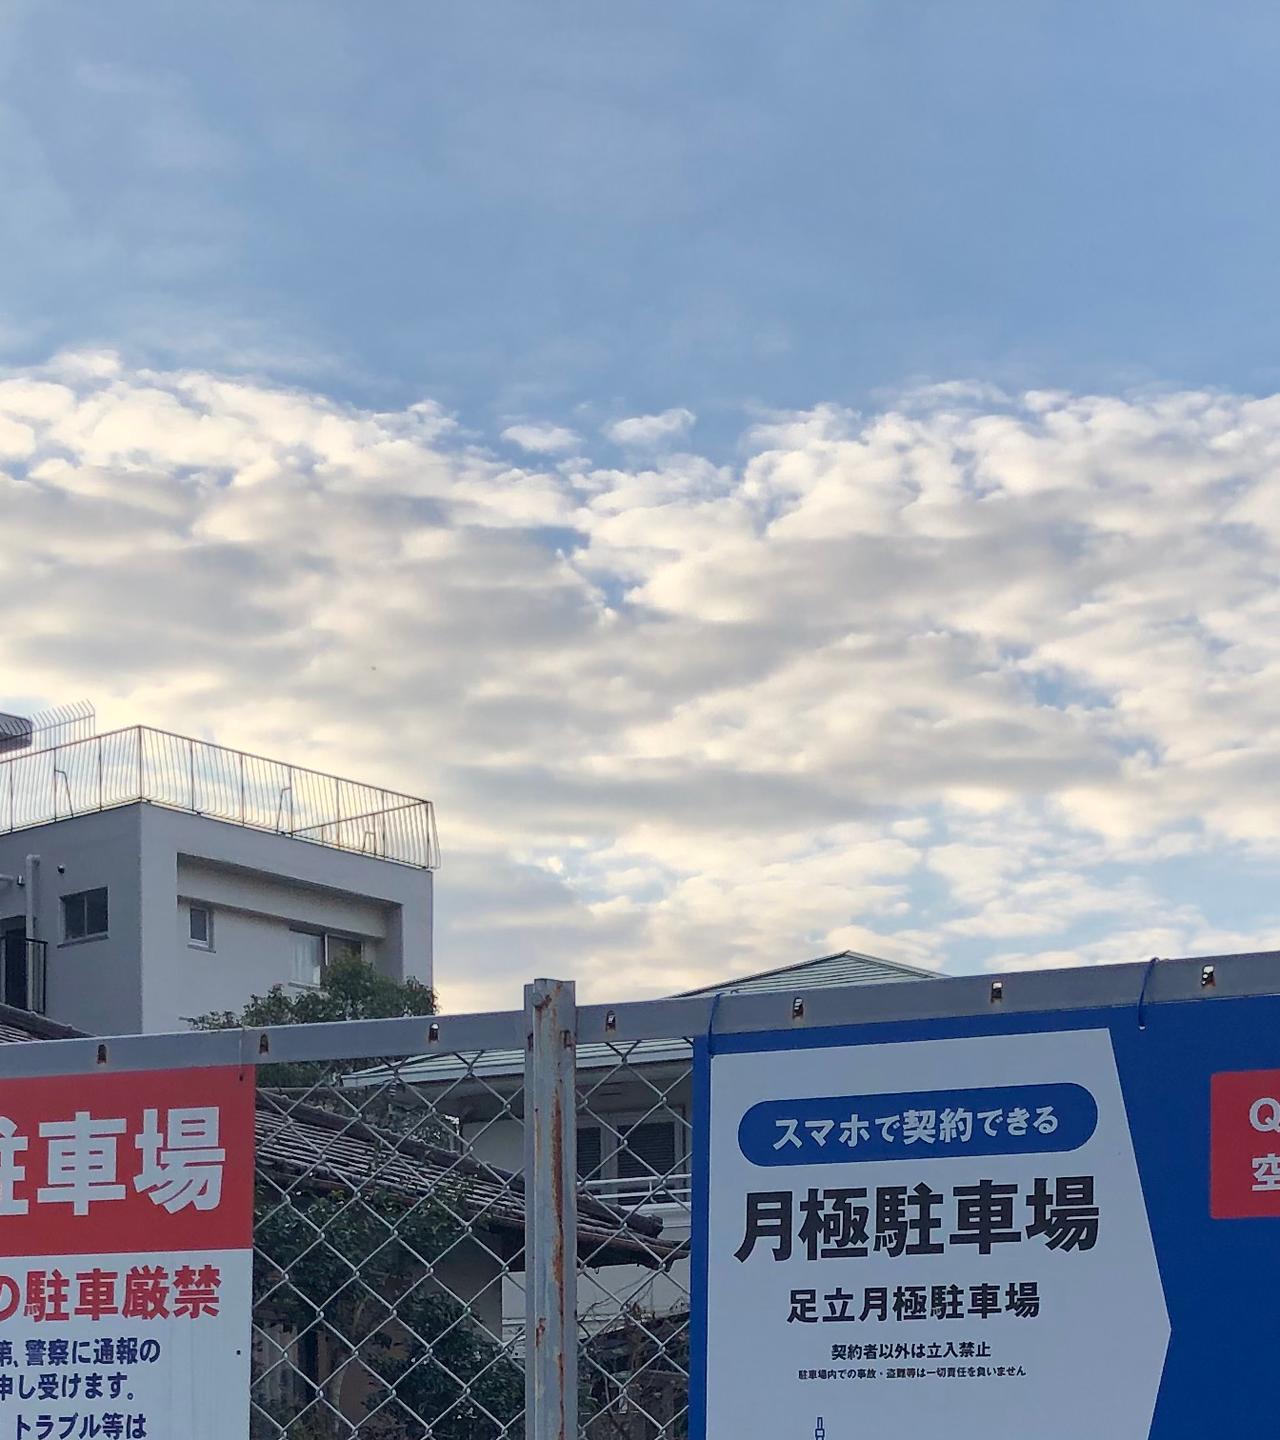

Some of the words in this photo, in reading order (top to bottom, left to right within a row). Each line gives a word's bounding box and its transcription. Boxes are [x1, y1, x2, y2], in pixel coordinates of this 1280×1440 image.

[773, 1104, 1059, 1151] スマホで契約できる
[733, 1175, 1100, 1264] 月極駐車場
[786, 1281, 1042, 1324] 足立月極駐車場
[831, 1341, 992, 1361] 契約者以外は立入禁止
